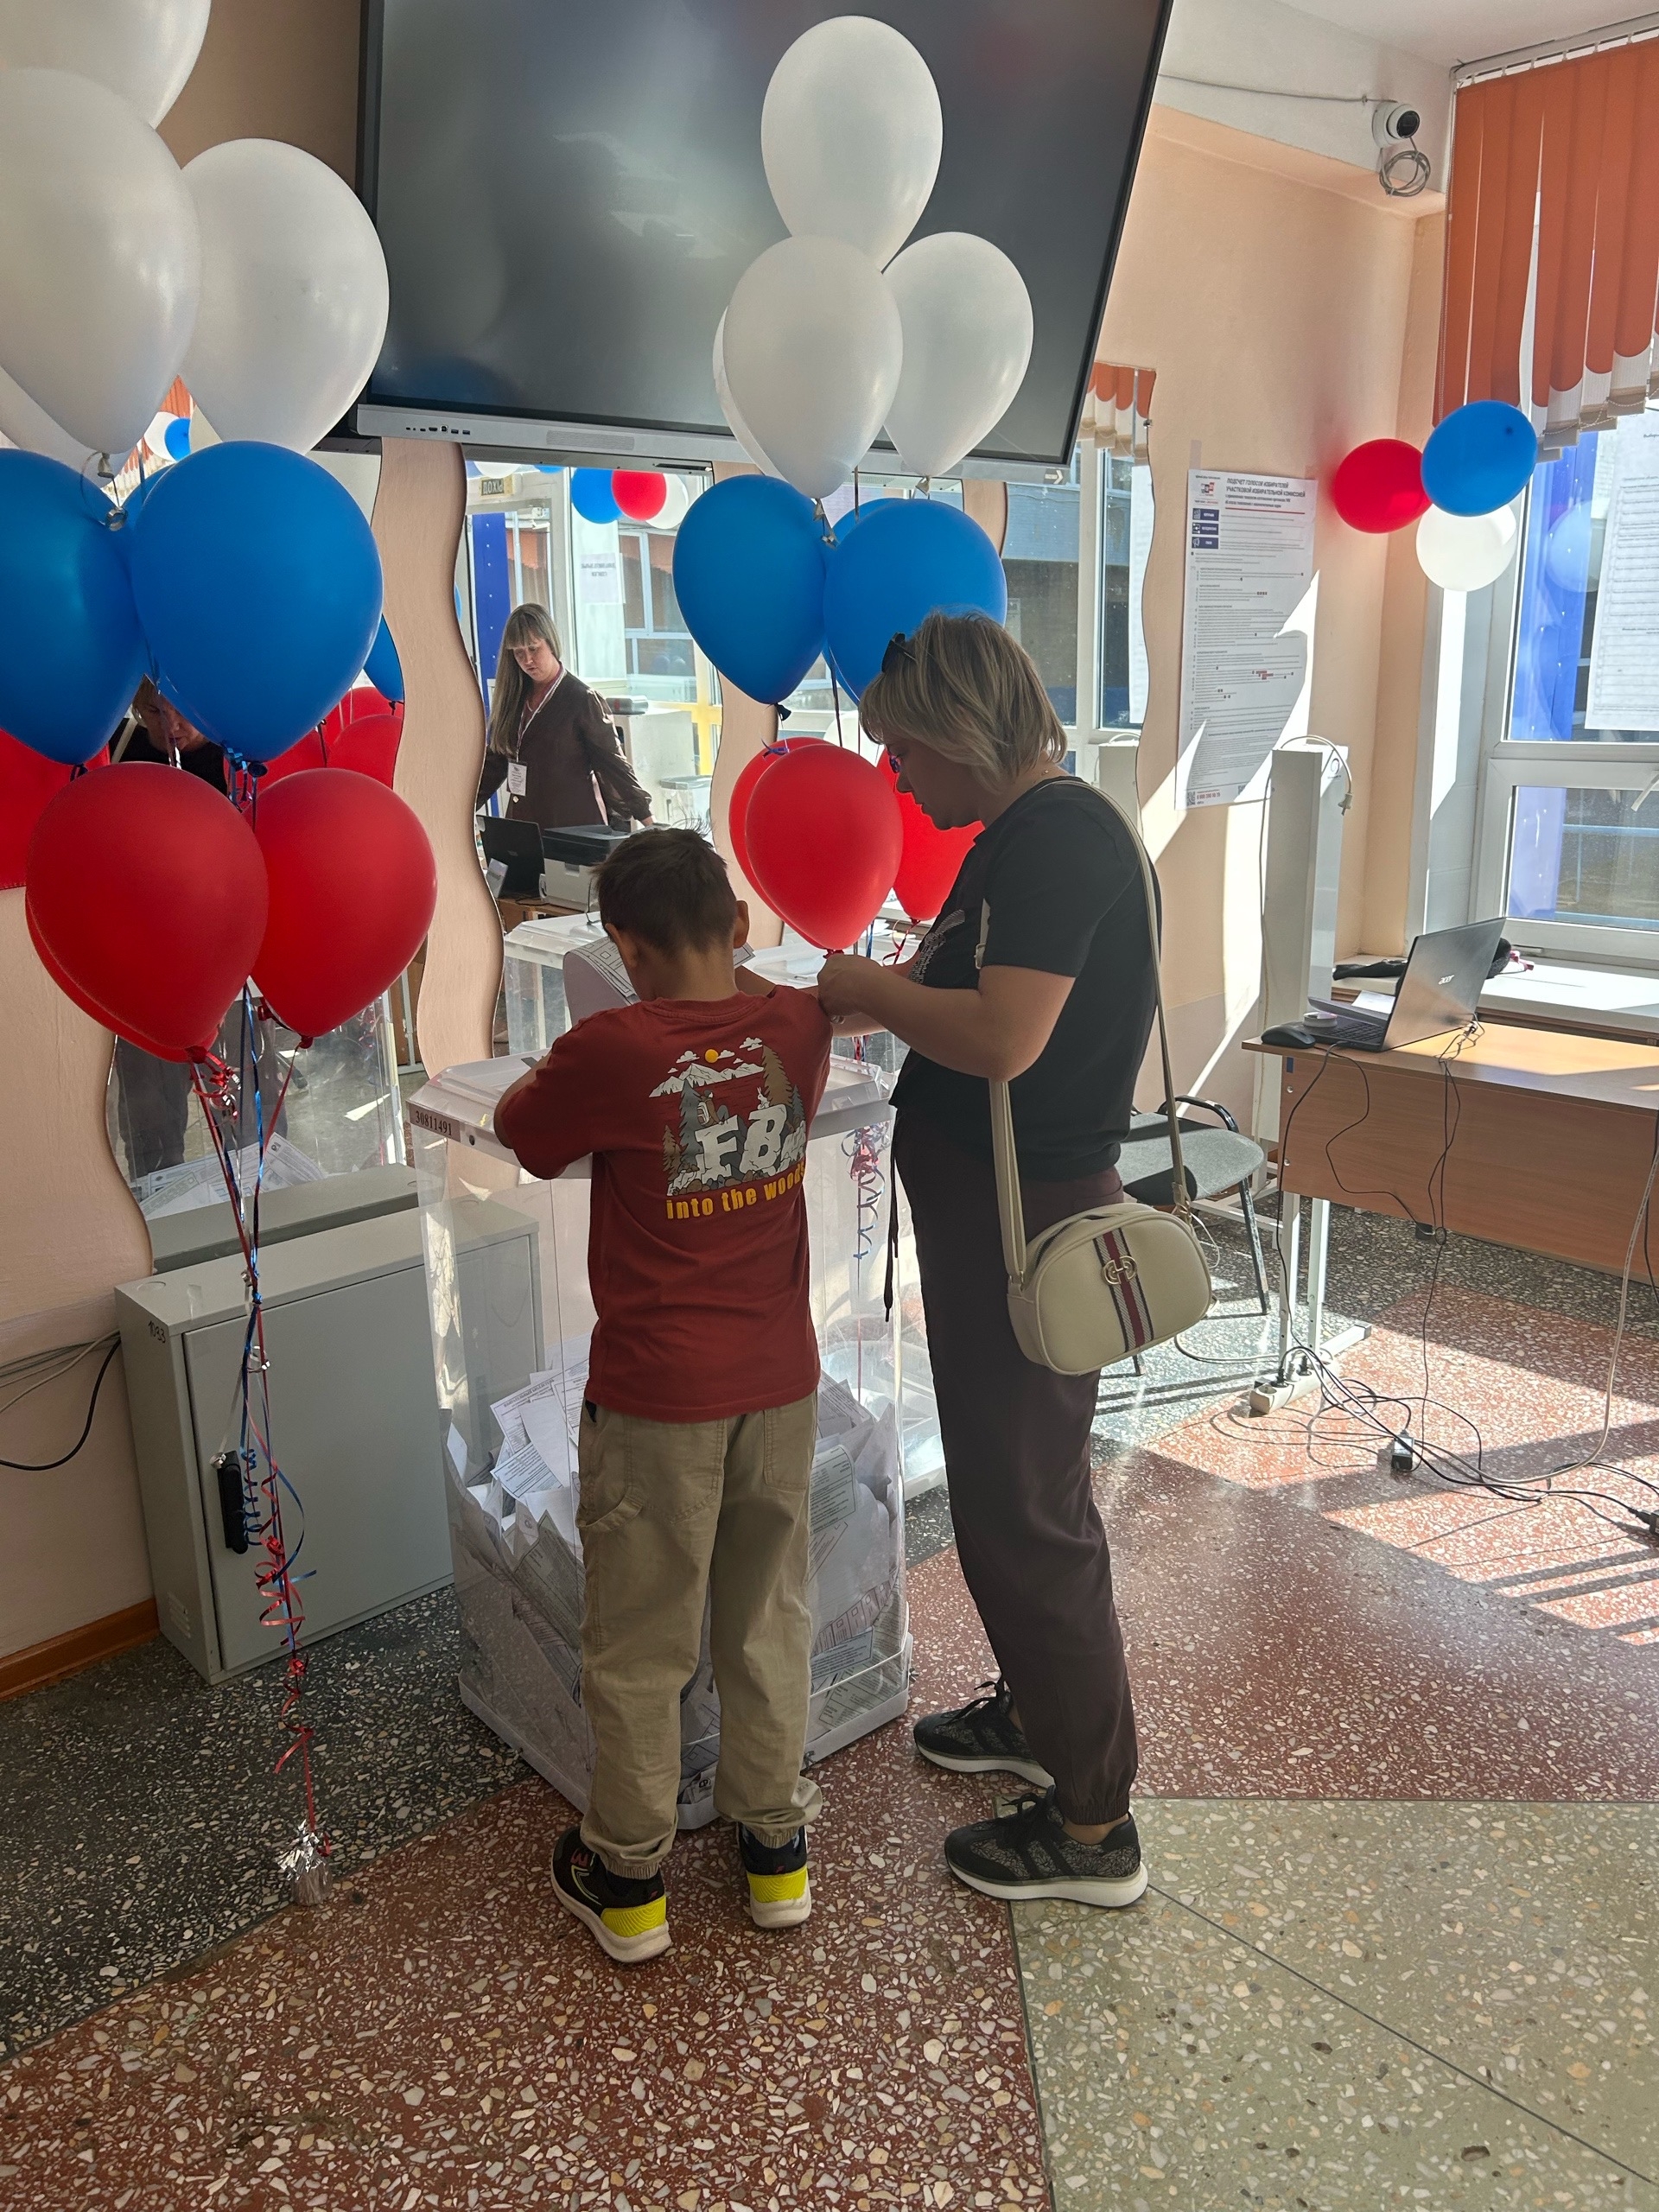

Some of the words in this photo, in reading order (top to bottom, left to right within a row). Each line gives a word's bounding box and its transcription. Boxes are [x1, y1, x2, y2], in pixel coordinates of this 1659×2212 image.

[1438, 974, 1454, 985] acer
[415, 1110, 452, 1136] 30811491
[666, 1198, 714, 1219] into
[721, 1188, 757, 1211] the
